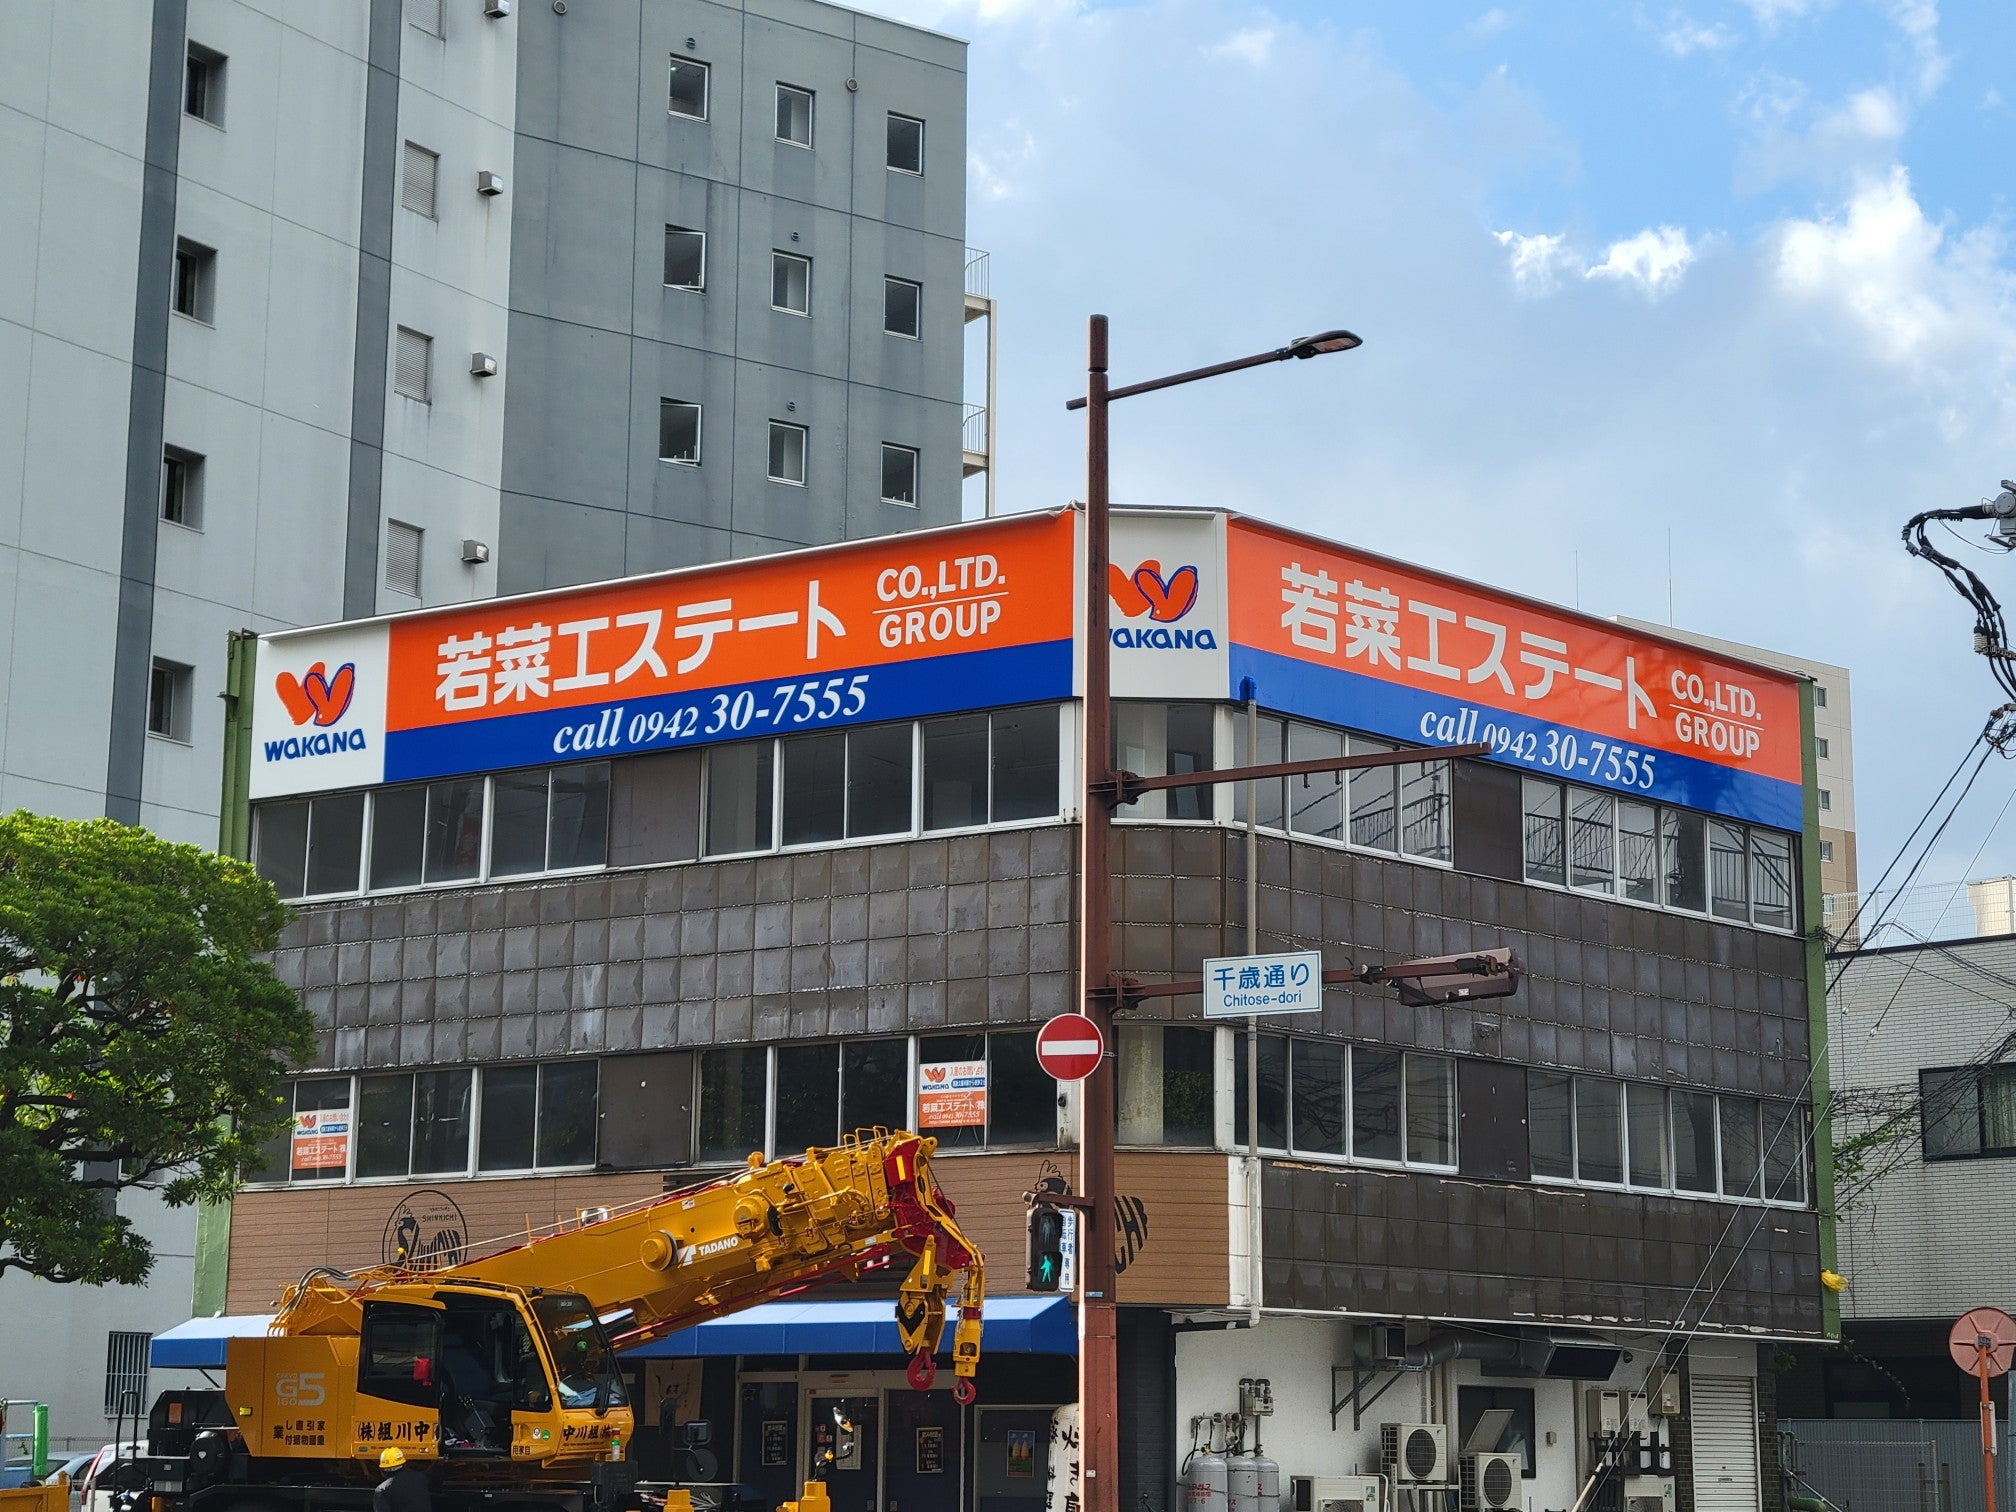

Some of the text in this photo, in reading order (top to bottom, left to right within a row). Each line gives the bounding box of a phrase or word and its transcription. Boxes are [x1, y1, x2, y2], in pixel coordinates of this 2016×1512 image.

[877, 554, 1005, 602] CO.,LTD.
[435, 579, 846, 712] 若菜エステート
[879, 600, 1001, 648] GROUP
[1281, 562, 1658, 730] 若菜エステート
[553, 674, 870, 753] call 0942 30-7555
[1671, 669, 1762, 721] CO.,LTD.
[1420, 707, 1656, 789] call 0942 30-7555
[1675, 711, 1760, 759] GROUP
[1213, 963, 1310, 991] 千歳通り
[1223, 991, 1302, 1008] Chitose-dori
[699, 1236, 738, 1256] TADANO
